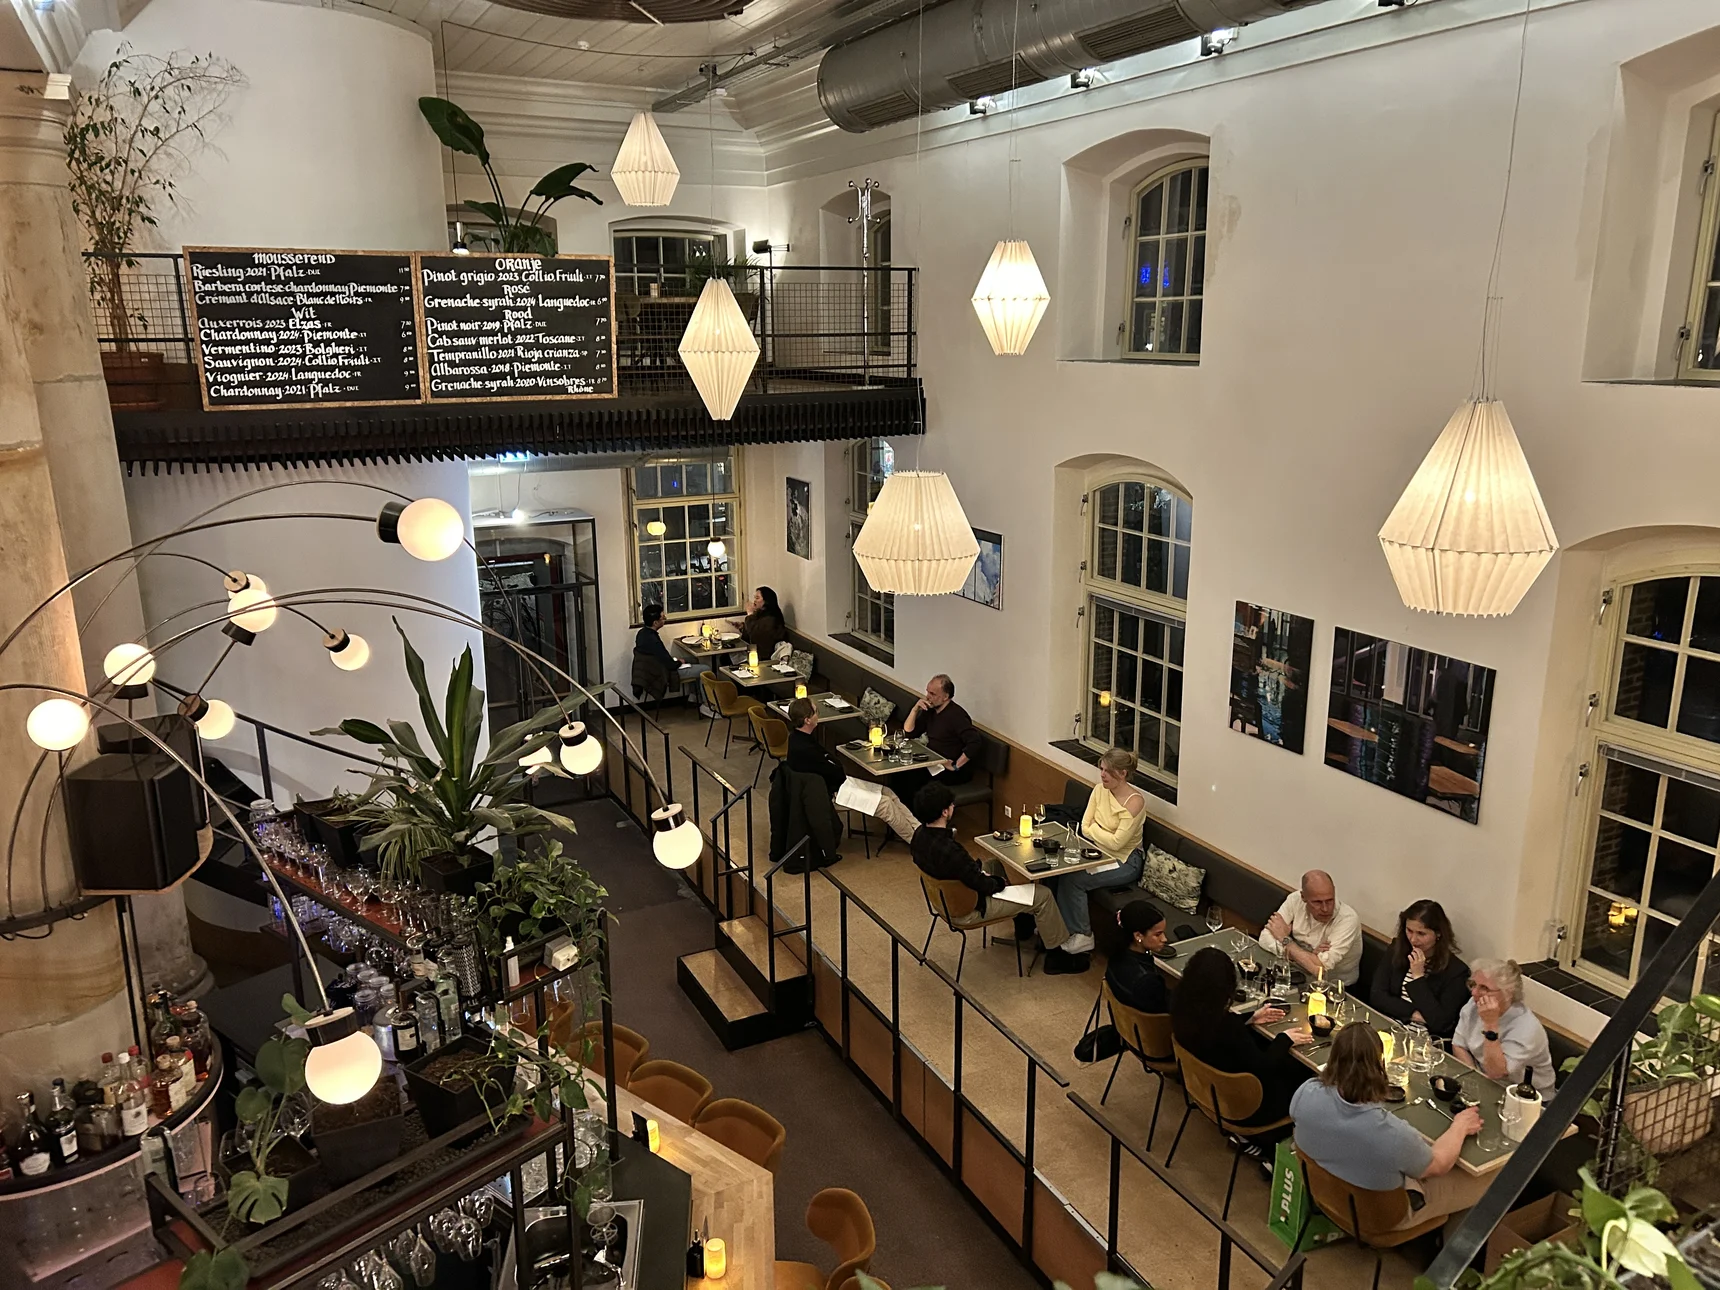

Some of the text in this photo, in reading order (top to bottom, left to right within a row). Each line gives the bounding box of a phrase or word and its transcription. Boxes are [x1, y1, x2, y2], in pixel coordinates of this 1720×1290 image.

[191, 264, 244, 281] Riesling
[245, 267, 266, 276] 2021
[268, 265, 306, 280] Pfalz
[421, 269, 458, 286] Pinot
[460, 270, 495, 285] grigio
[497, 272, 519, 281] 2023
[556, 269, 584, 282] Friuli
[246, 281, 284, 292] cortese
[285, 282, 348, 296] chardonnay
[348, 282, 398, 296] Piemonte
[502, 282, 530, 298] Rosé
[195, 293, 248, 305] Crémant
[294, 293, 324, 305] Blanc
[325, 294, 335, 304] de
[336, 294, 363, 305] Noirs
[424, 293, 480, 308] Grenache
[482, 295, 514, 311] syrah
[516, 297, 536, 306] 2024
[538, 294, 589, 311] Languedoc
[291, 306, 317, 319] Wit
[502, 307, 533, 320] Rood
[198, 318, 263, 328] Auxerrois
[264, 320, 286, 328] 2023
[289, 318, 321, 329] Elzas
[425, 317, 459, 334] Pinot
[460, 320, 480, 330] noir
[482, 321, 500, 331] 2019
[502, 318, 533, 332] Pfalz
[200, 328, 278, 343] Chardonnay
[278, 330, 300, 340] 2024
[302, 328, 358, 343] Piemonte
[452, 337, 478, 346] sauv
[479, 333, 514, 345] merlot
[515, 335, 535, 343] 2022
[535, 333, 576, 344] Toscane
[202, 343, 275, 355] Vermentino
[278, 345, 302, 354] 2023
[304, 342, 355, 356] Bolgheri
[428, 346, 496, 363] Tempranillo
[498, 349, 514, 358] 2021
[515, 346, 543, 361] Rioja
[544, 348, 580, 358] crianza
[204, 356, 275, 370] Sauvignon
[277, 357, 301, 366] 2024
[338, 354, 370, 366] Friuli
[431, 362, 488, 376] Albarossa
[491, 363, 510, 373] 2018
[512, 361, 561, 377] Piemonte
[206, 369, 263, 386] Viognier
[266, 372, 288, 381] 2024
[292, 368, 351, 383] Languedoc
[431, 378, 484, 391] Grenache
[484, 376, 514, 392] syrah
[515, 378, 535, 387] 2020
[537, 375, 586, 387] Vinsobres
[210, 385, 282, 399] Chardonnay
[284, 385, 305, 394] 2021
[307, 383, 342, 398] Pfalz
[565, 385, 594, 393] Rhône
[1281, 1168, 1294, 1214] PLUS
